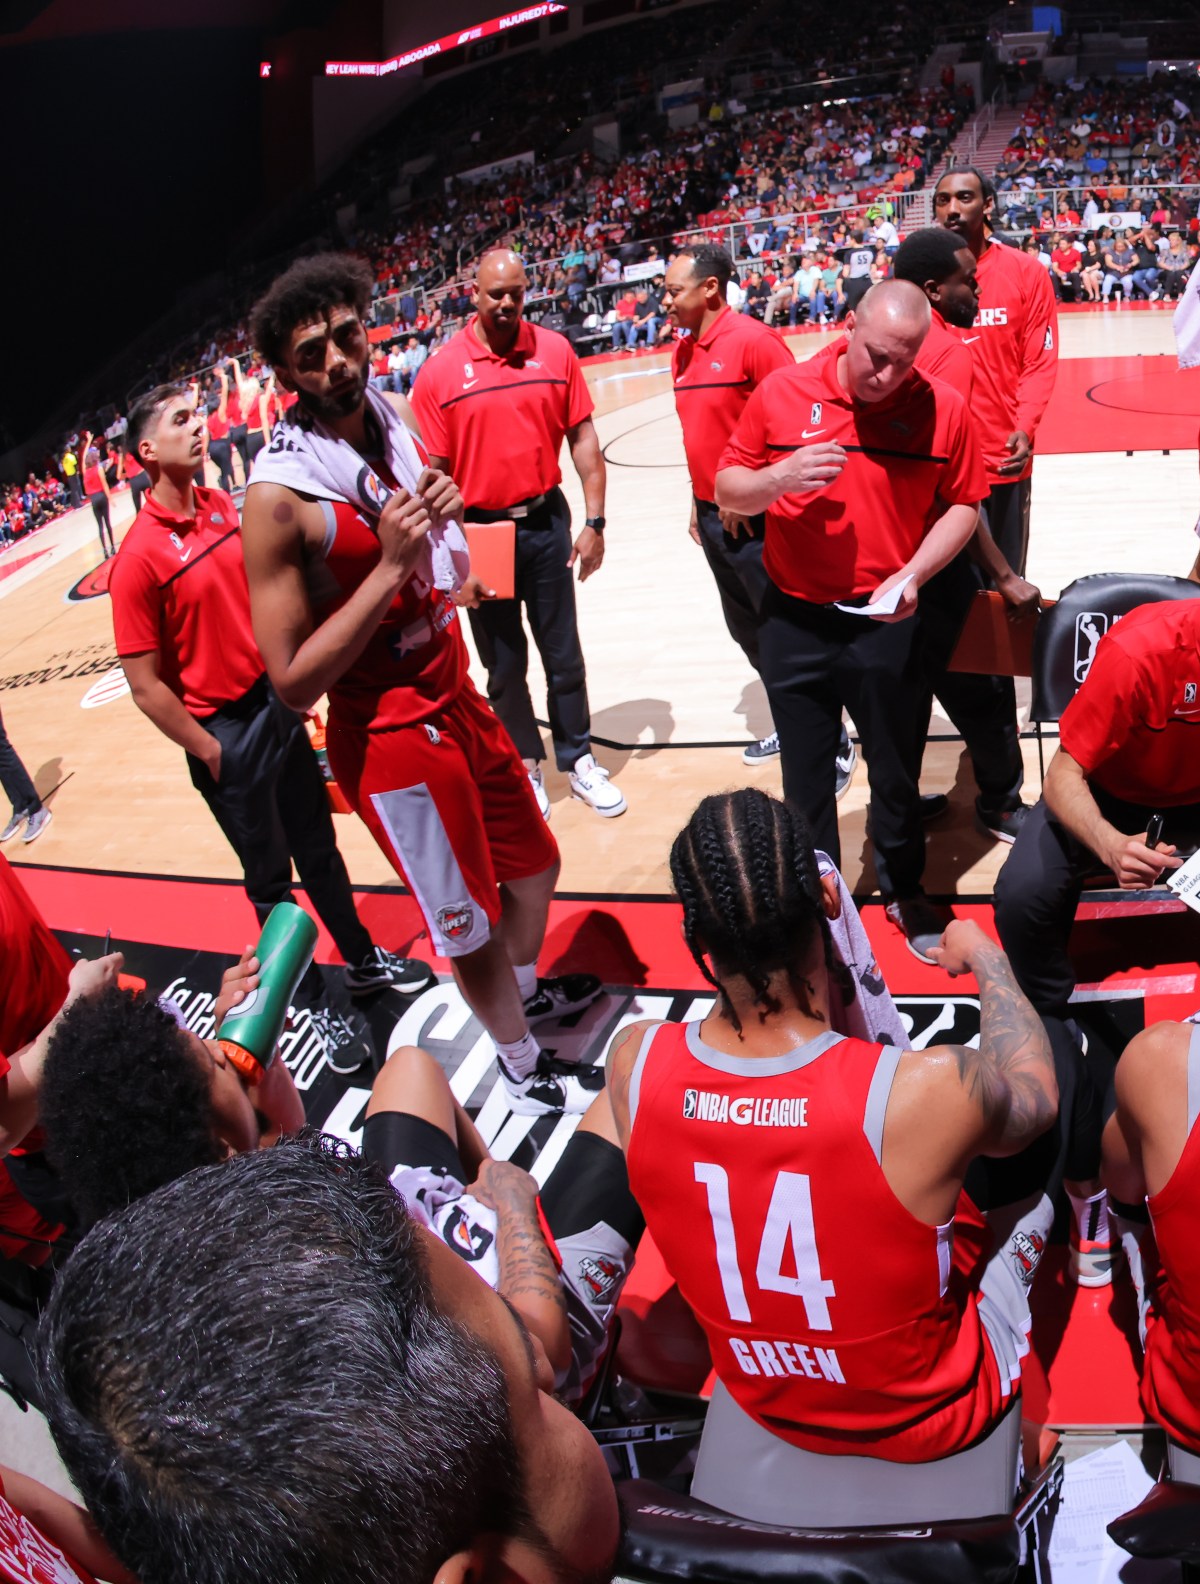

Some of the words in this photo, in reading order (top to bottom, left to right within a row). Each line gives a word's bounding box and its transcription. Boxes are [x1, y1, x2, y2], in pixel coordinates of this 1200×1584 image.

[499, 5, 548, 29] INJURED?
[399, 43, 441, 67] ABOGADA
[1175, 874, 1189, 888] NBA
[693, 1161, 836, 1331] 14
[728, 1338, 846, 1384] GREEN
